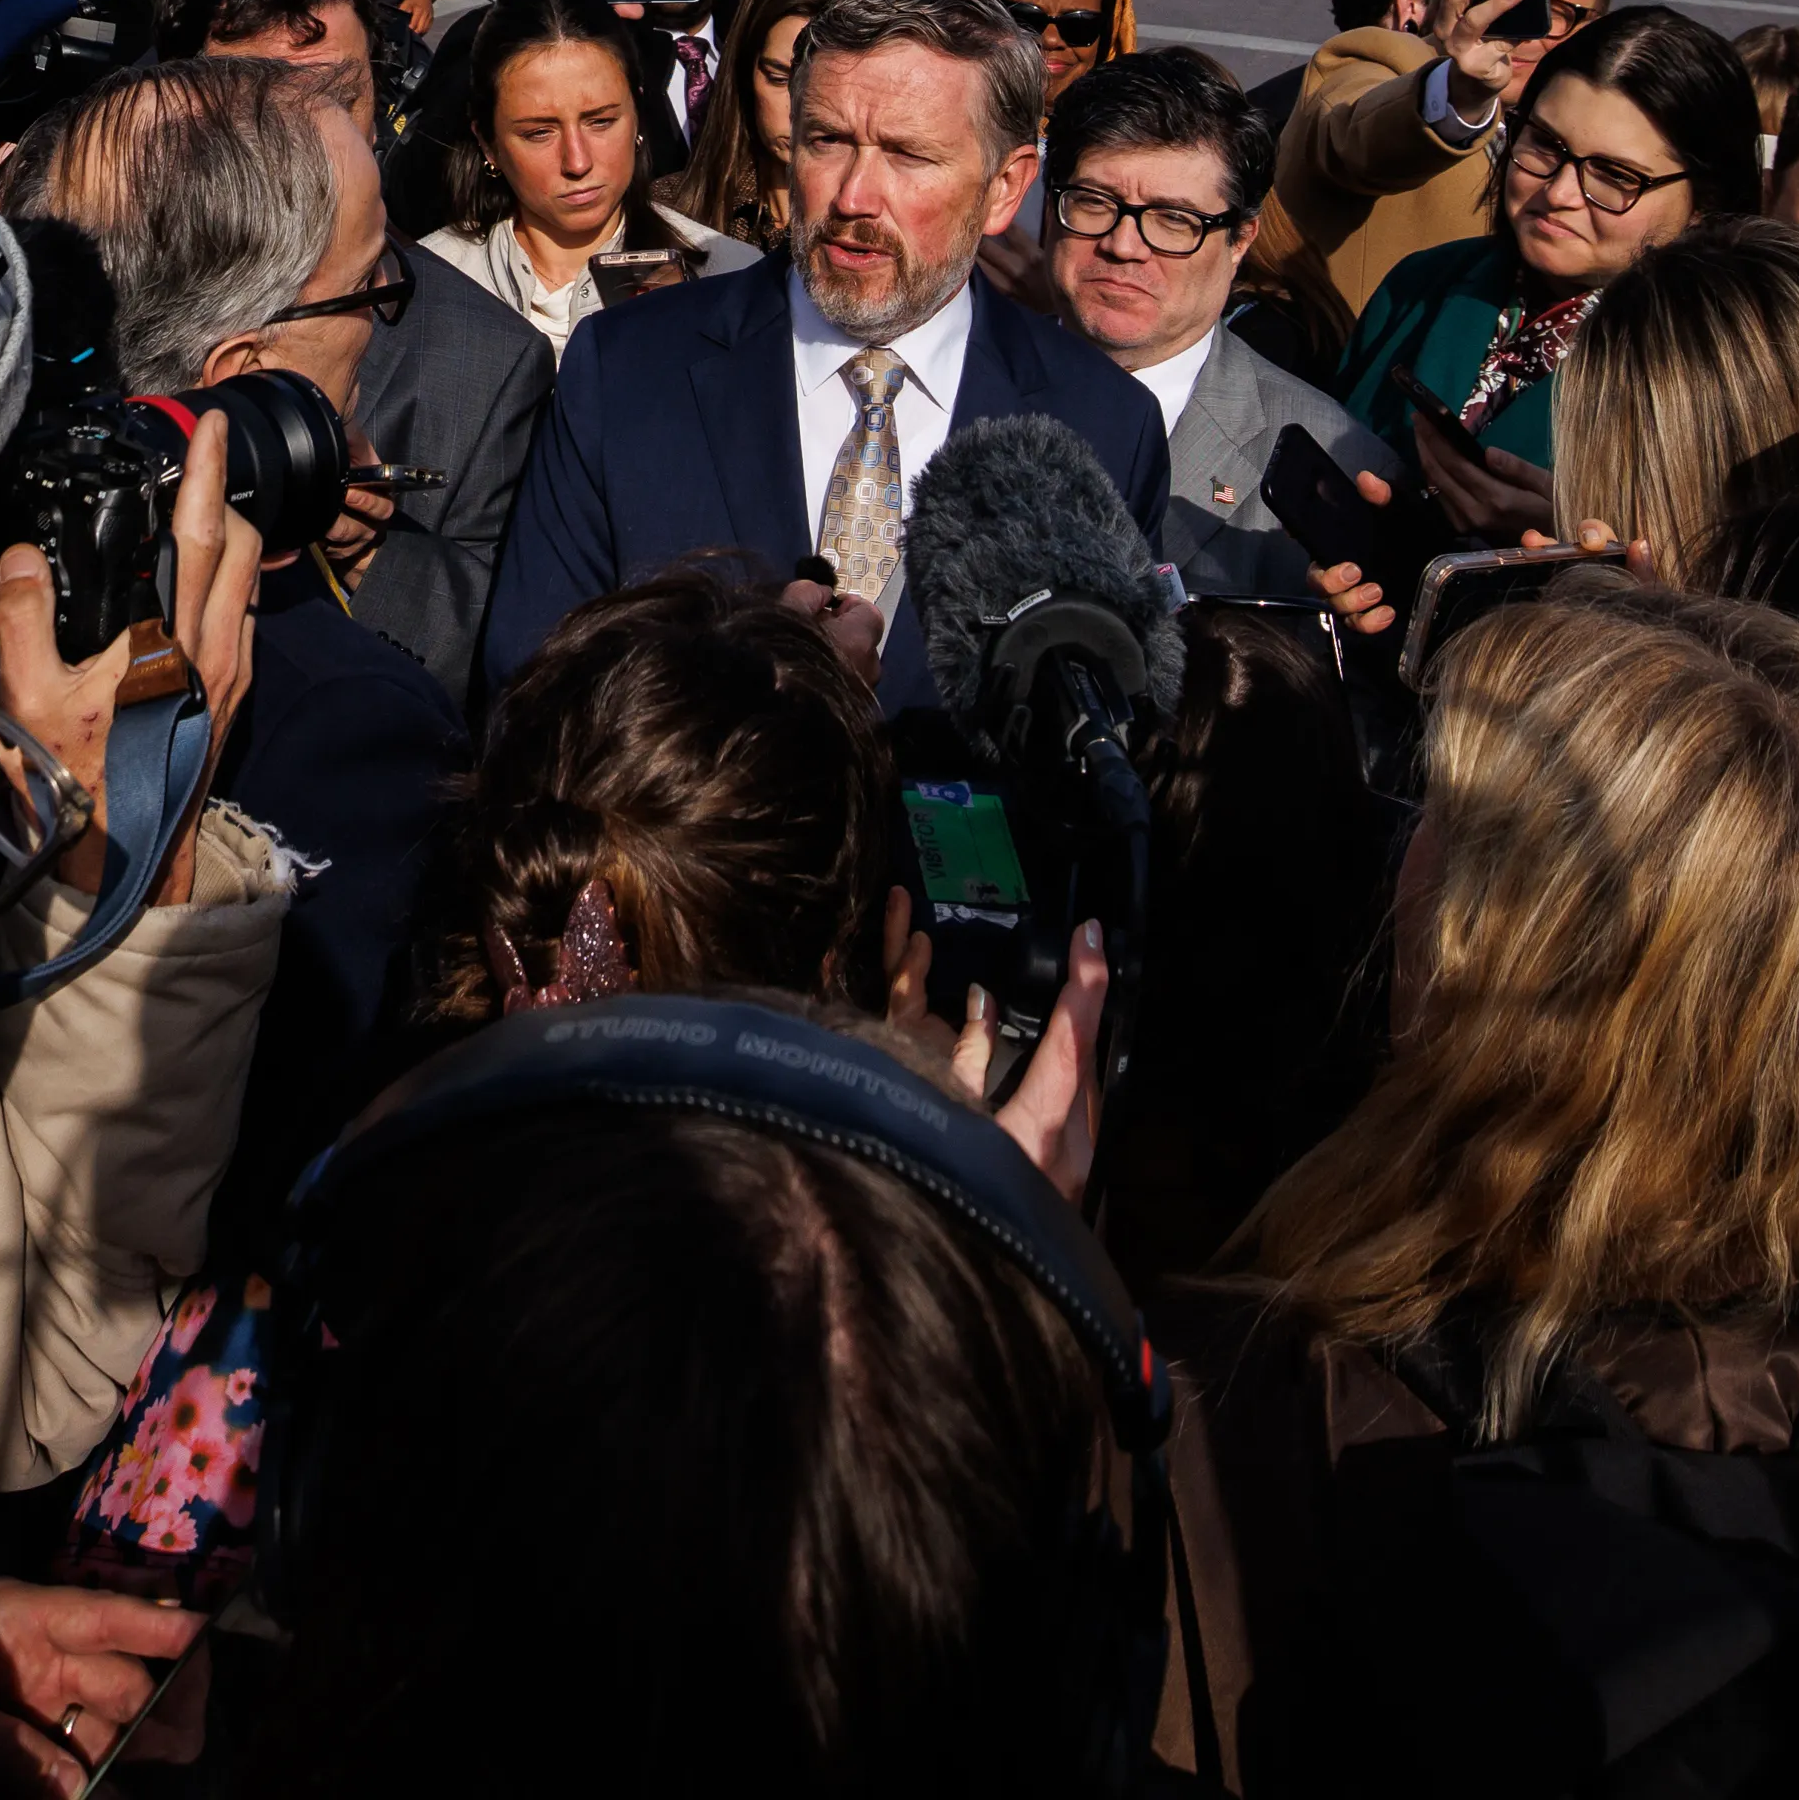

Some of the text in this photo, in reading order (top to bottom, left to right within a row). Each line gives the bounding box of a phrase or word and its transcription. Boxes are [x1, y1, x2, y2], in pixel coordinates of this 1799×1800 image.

[230, 489, 255, 502] SONY
[914, 811, 947, 880] VISITOR
[543, 1016, 949, 1132] STUDIO MONITOR
